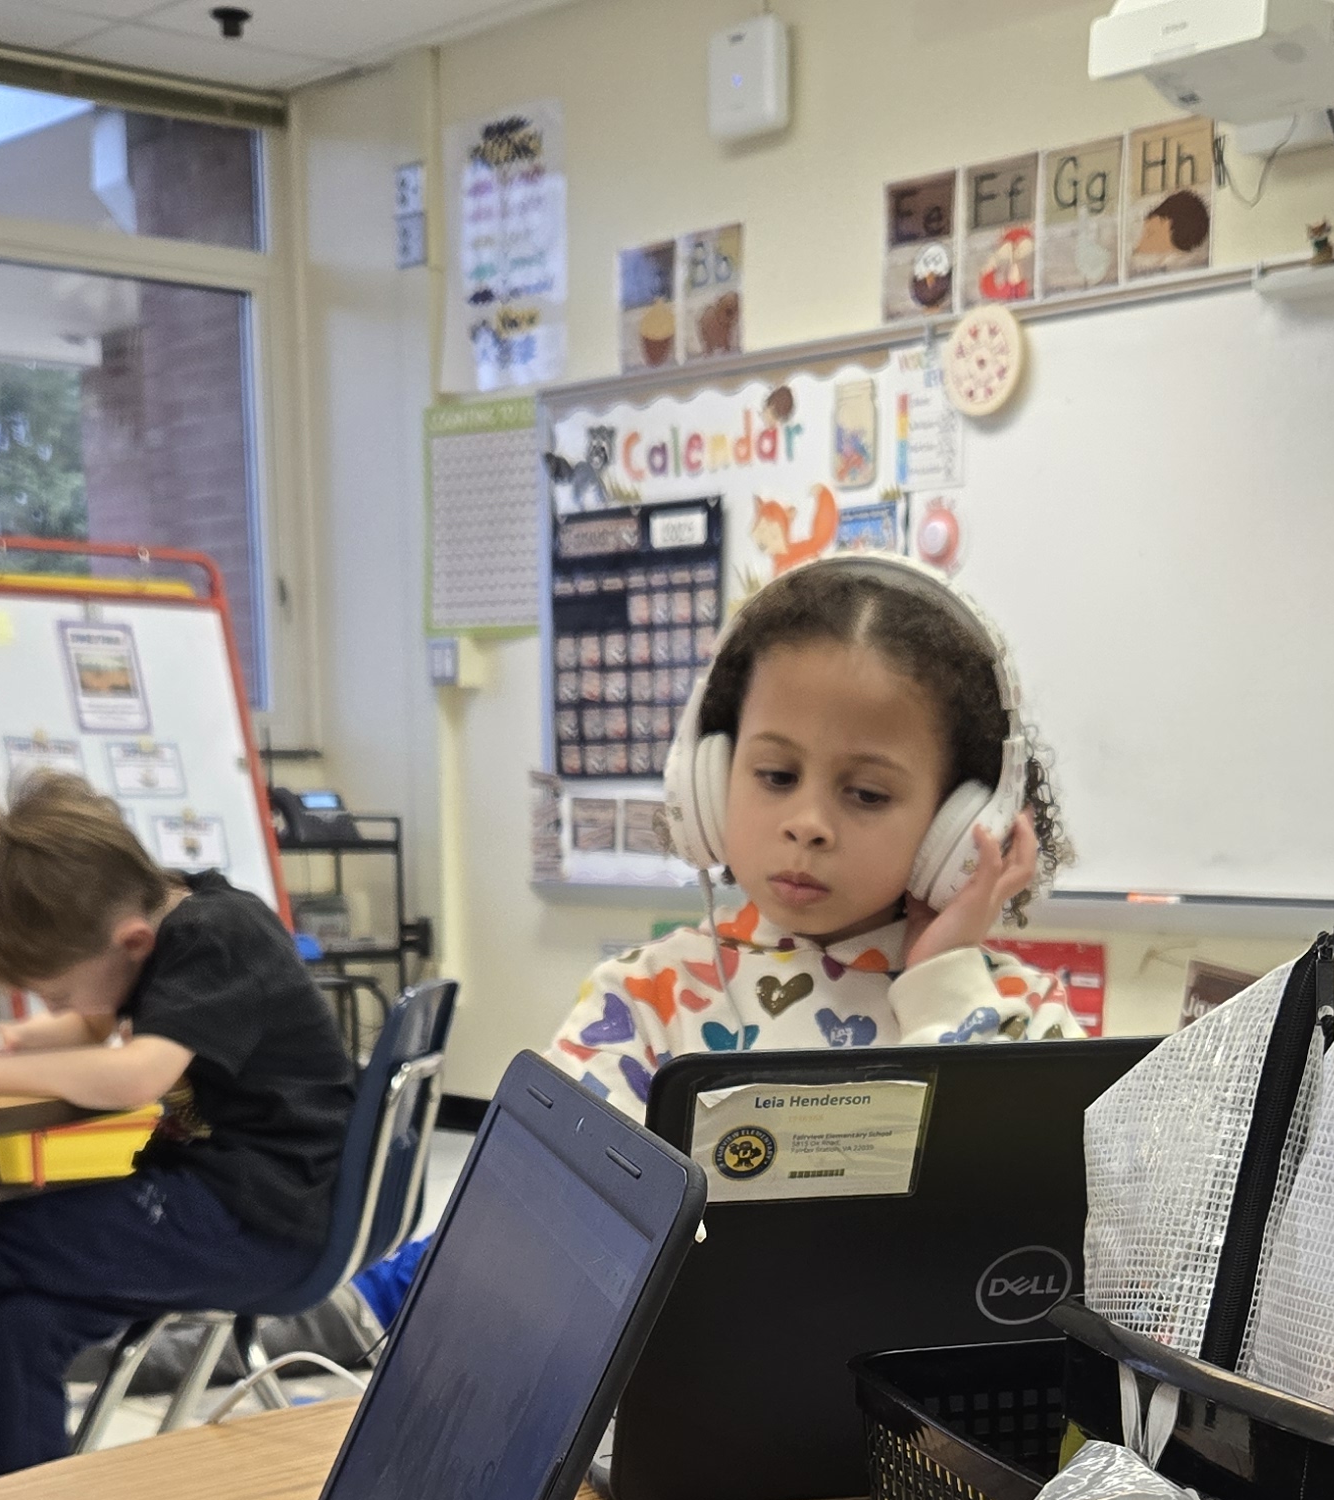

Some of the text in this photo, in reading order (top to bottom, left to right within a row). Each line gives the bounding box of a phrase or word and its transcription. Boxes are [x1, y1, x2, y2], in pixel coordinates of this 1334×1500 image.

[622, 408, 804, 481] Calendar
[755, 1094, 871, 1109] Leia Henderson
[826, 1131, 867, 1141] Elementary
[868, 1130, 893, 1139] School
[988, 1276, 1060, 1297] DELL
